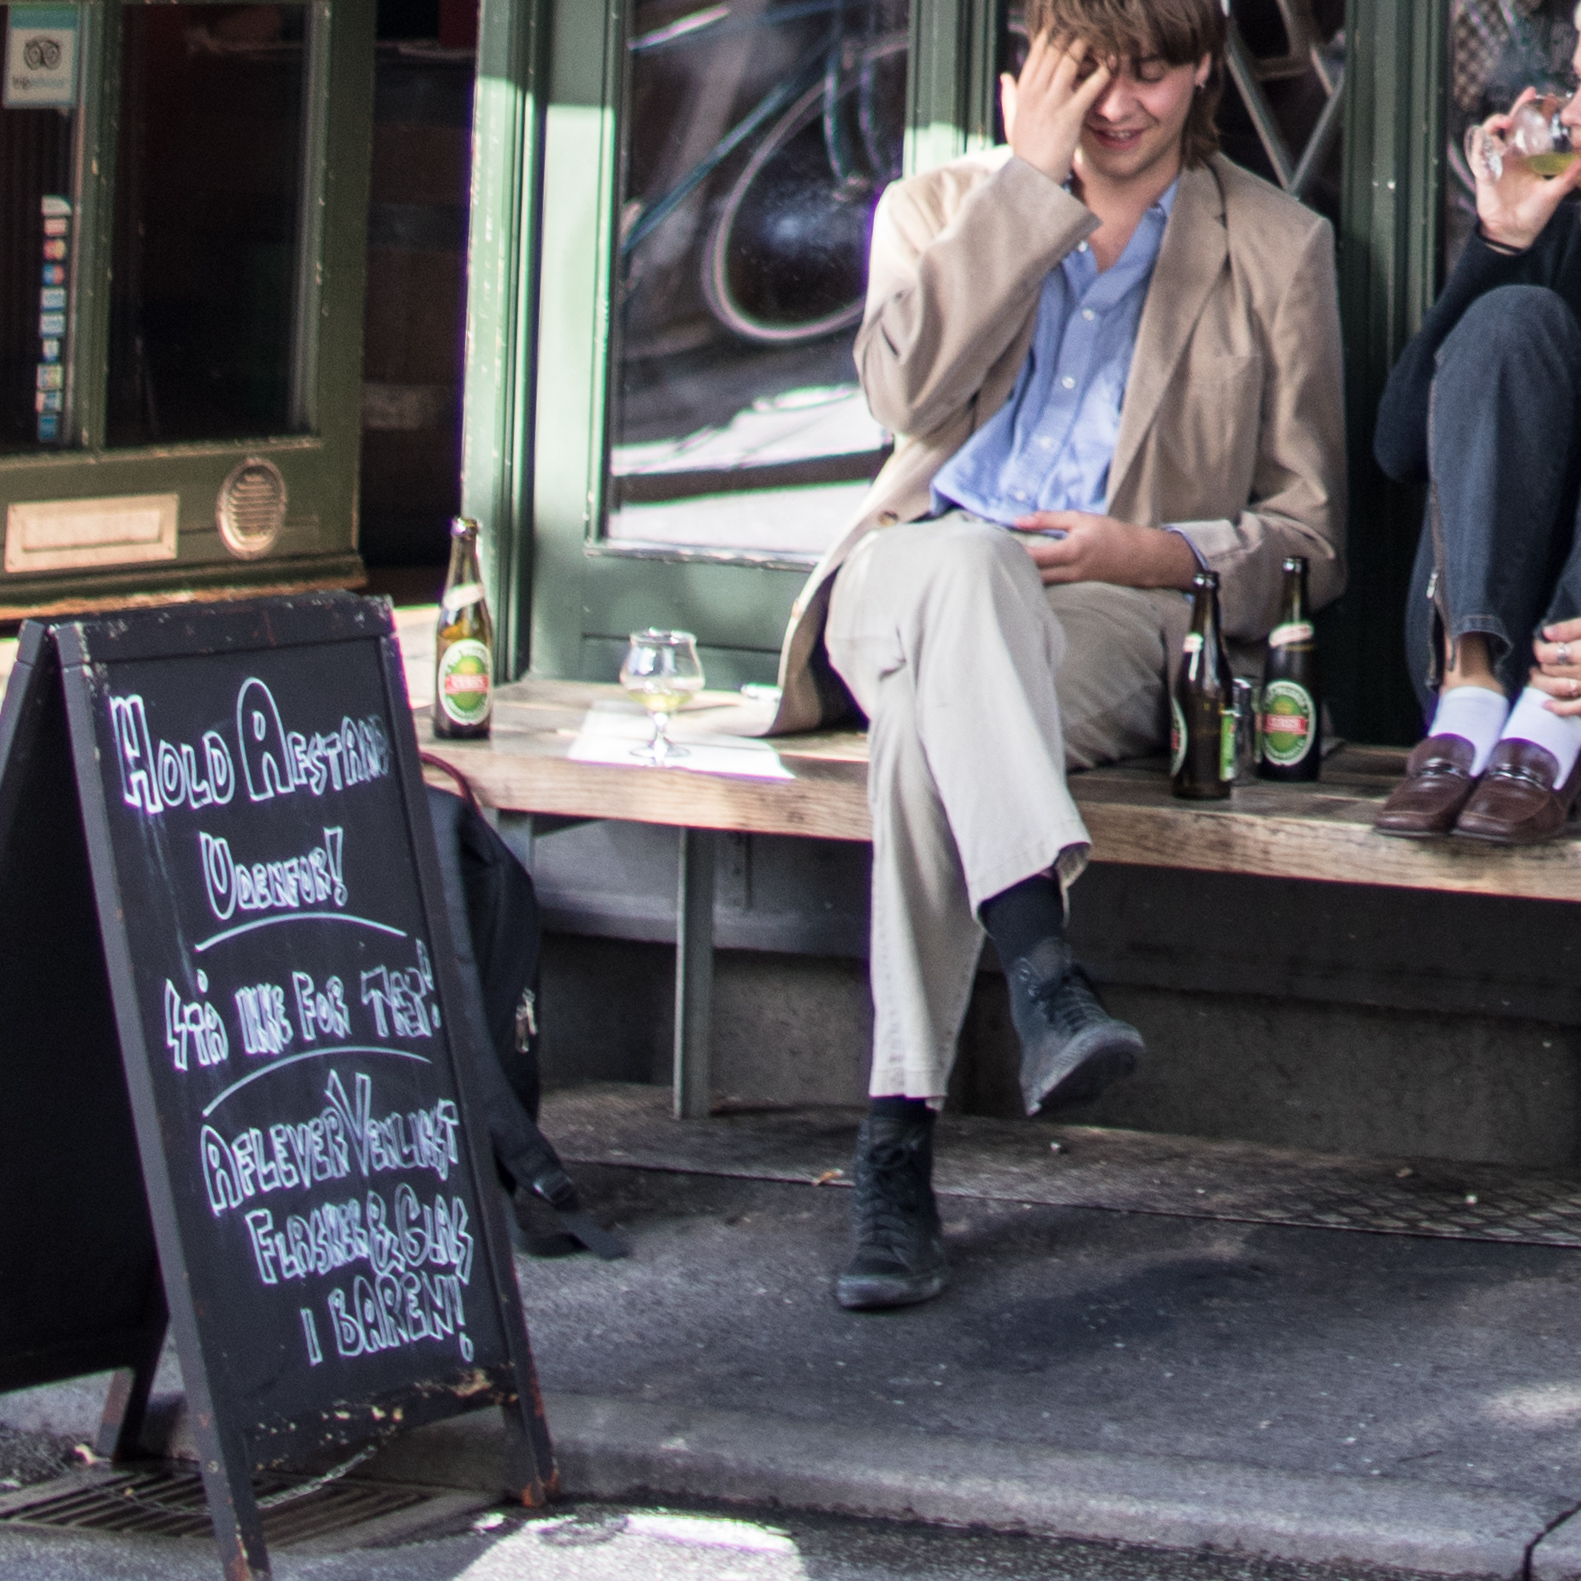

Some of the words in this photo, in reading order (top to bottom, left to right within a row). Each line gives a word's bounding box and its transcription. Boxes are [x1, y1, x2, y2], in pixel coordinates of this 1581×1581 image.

[109, 694, 235, 815] HOLD
[199, 826, 348, 921] UDENFOR!
[165, 968, 229, 1071] STÅ
[292, 970, 353, 1041] FOR
[200, 1104, 351, 1218] AFLEVER
[300, 1307, 323, 1367] I
[327, 1269, 475, 1363] BAREN!
